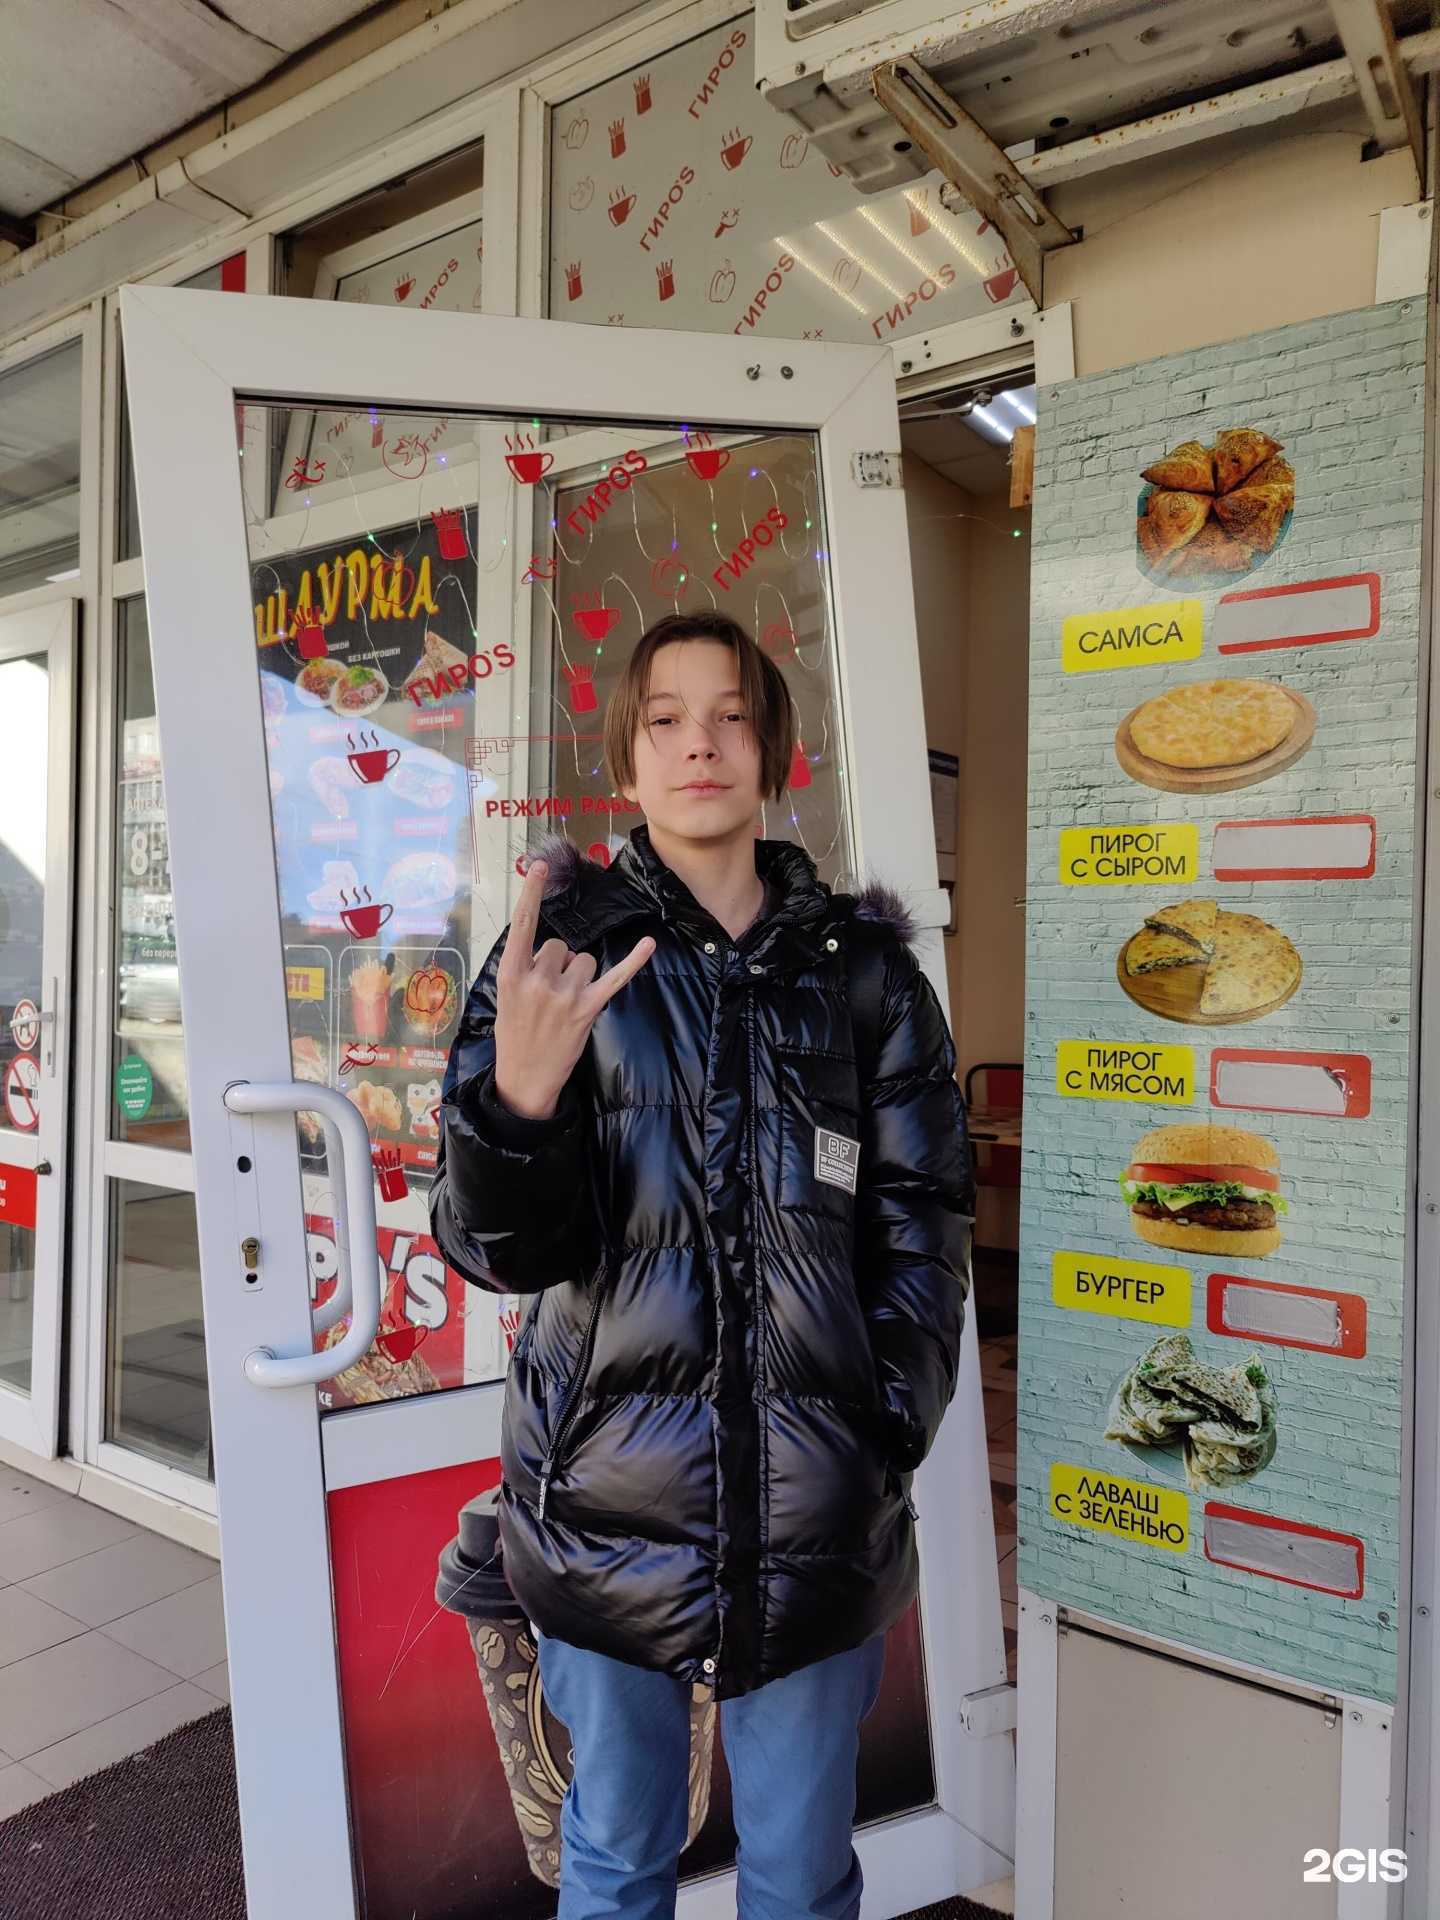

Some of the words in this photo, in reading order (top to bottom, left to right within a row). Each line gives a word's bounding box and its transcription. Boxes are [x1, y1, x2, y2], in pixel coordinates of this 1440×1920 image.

[1078, 620, 1184, 654] САМСА
[485, 797, 573, 818] РЕЖИМ
[581, 795, 641, 816] РАБО
[1090, 832, 1167, 855] ПИРОГ
[1070, 858, 1089, 878] С
[1095, 855, 1186, 878] СЫРОМ
[1087, 1048, 1163, 1072] ПИРОГ
[1065, 1070, 1083, 1090] С
[1089, 1071, 1185, 1097] МЯСОМ
[1076, 1271, 1166, 1305] БУРГЕР
[1076, 1476, 1159, 1515] ЛАВАШ
[1054, 1493, 1073, 1514] С
[1079, 1499, 1185, 1544] ЗЕЛЕНЬЮ
